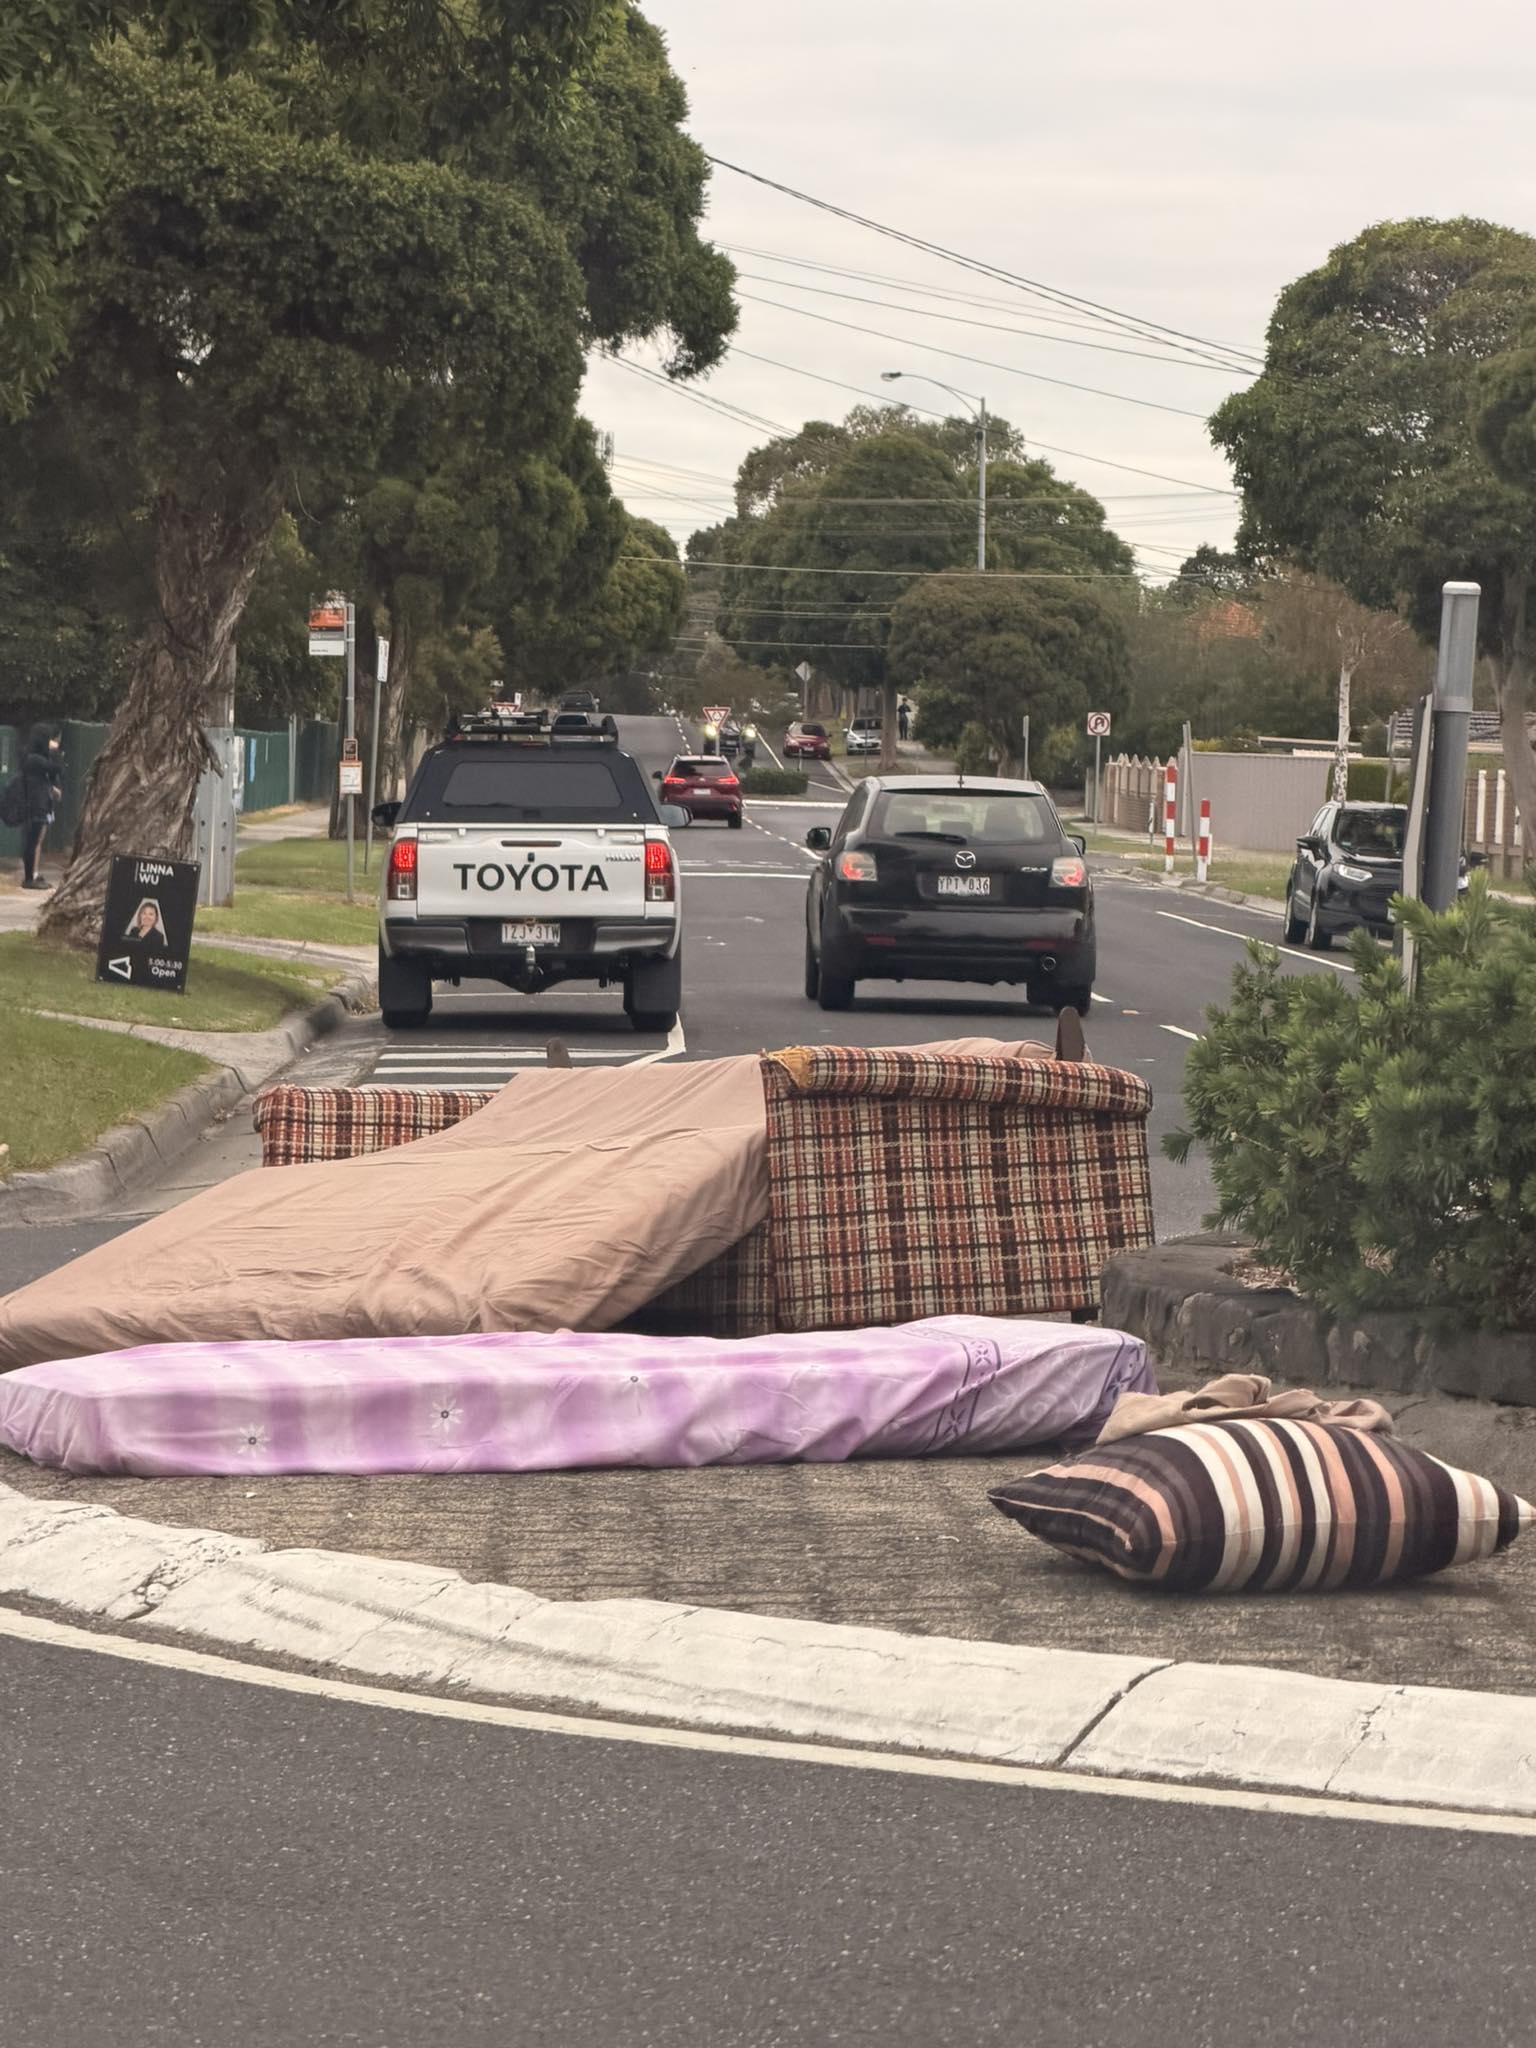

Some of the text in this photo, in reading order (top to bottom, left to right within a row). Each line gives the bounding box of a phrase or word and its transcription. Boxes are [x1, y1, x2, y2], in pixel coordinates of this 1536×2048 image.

[139, 862, 174, 877] LINNA
[139, 873, 159, 885] WU
[453, 863, 609, 892] TOYOTA
[504, 925, 559, 940] 1ZJ 3TW
[151, 966, 176, 978] Open
